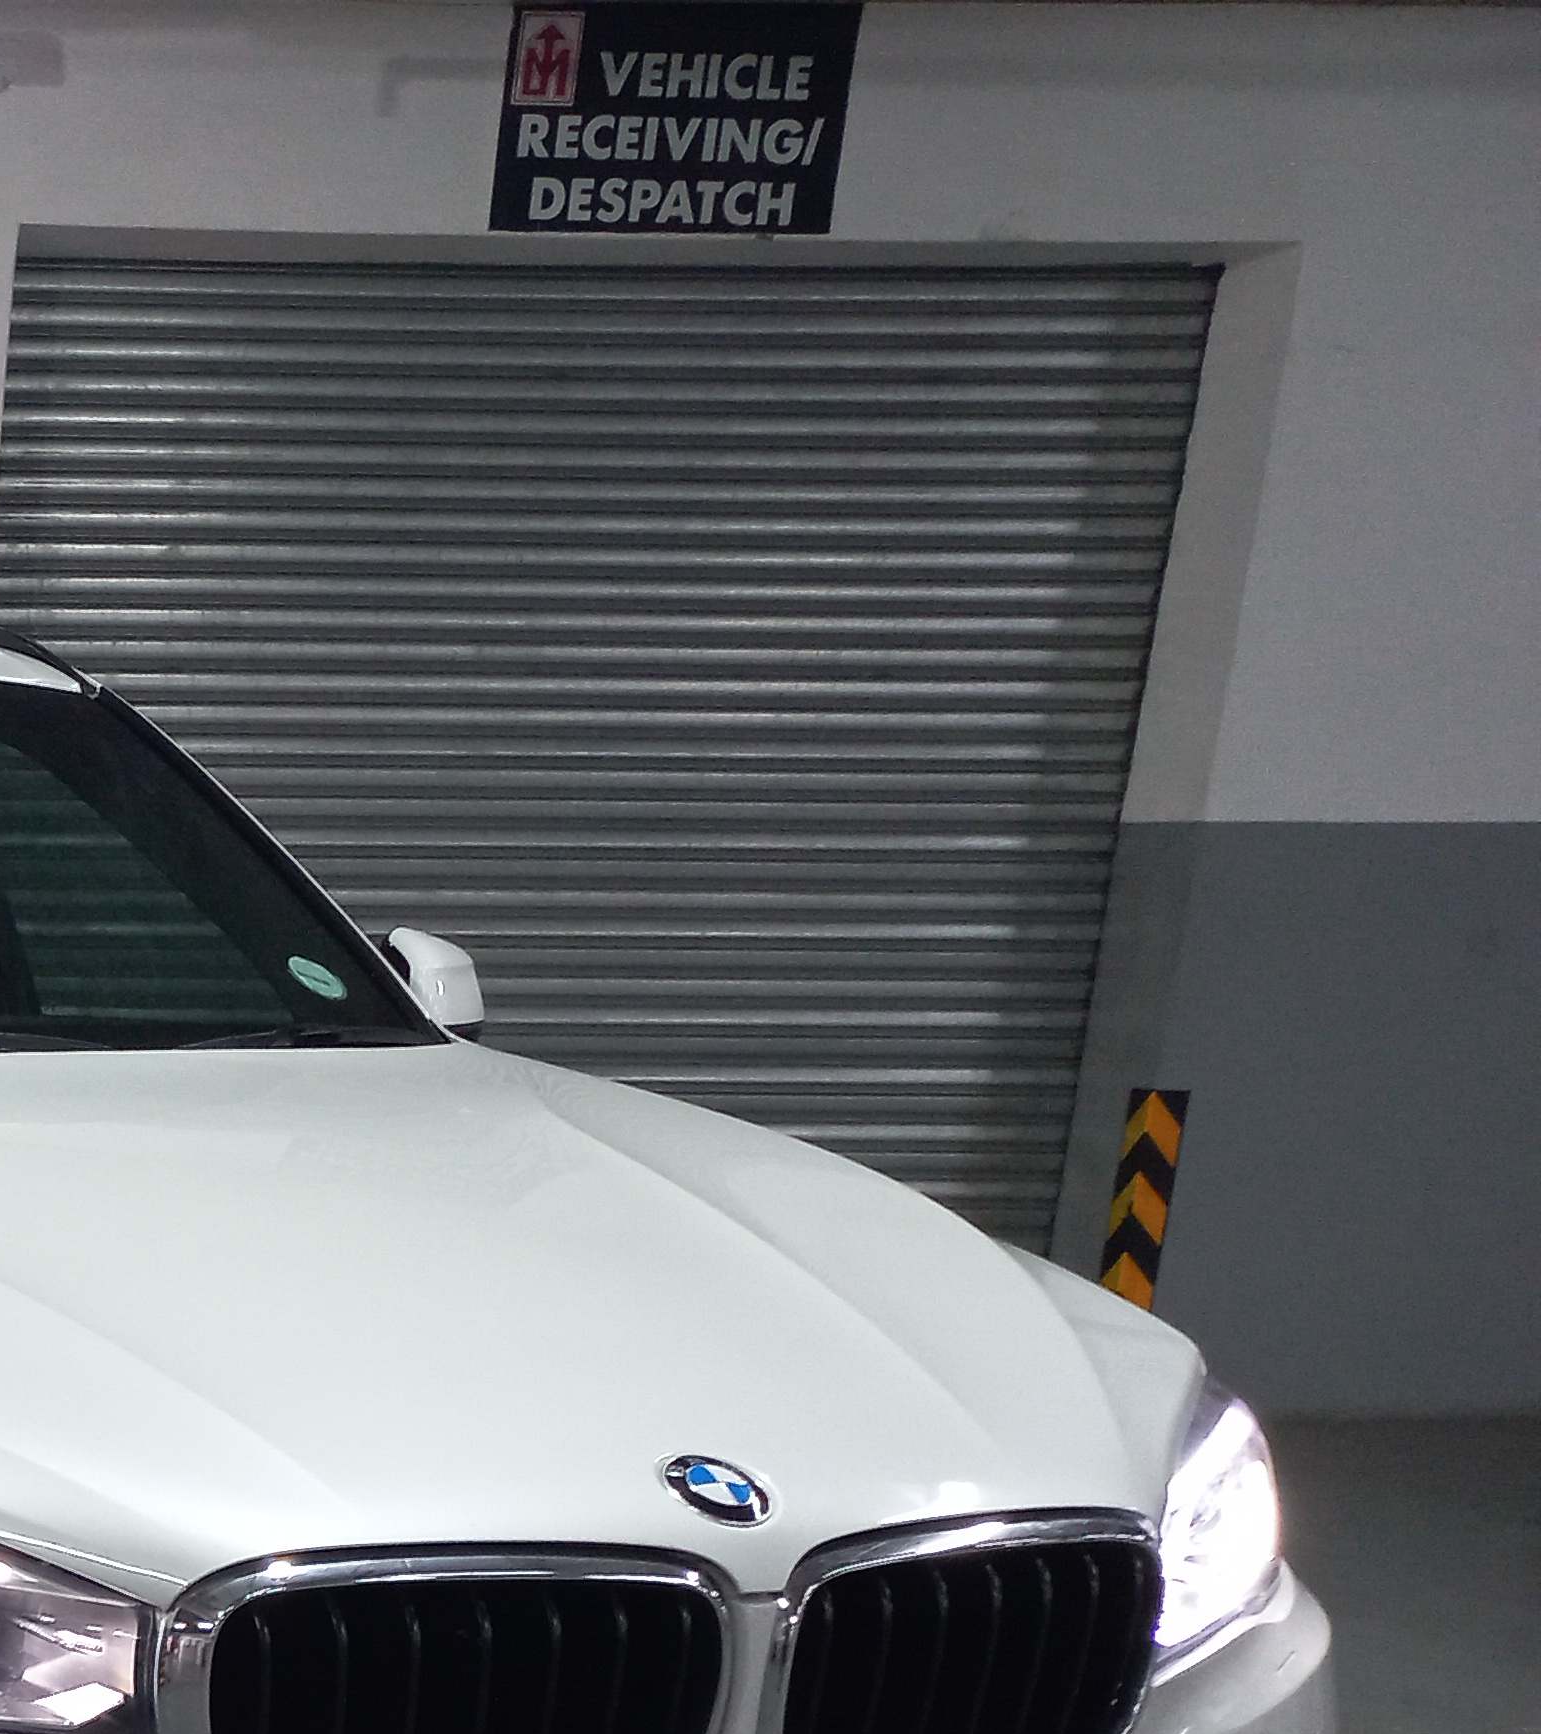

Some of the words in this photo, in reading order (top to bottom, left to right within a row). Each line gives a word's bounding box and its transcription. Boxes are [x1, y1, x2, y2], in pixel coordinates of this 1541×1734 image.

[599, 51, 814, 101] VEHICLE
[517, 113, 825, 166] RECEIVING/
[528, 177, 797, 227] DESPATCH
